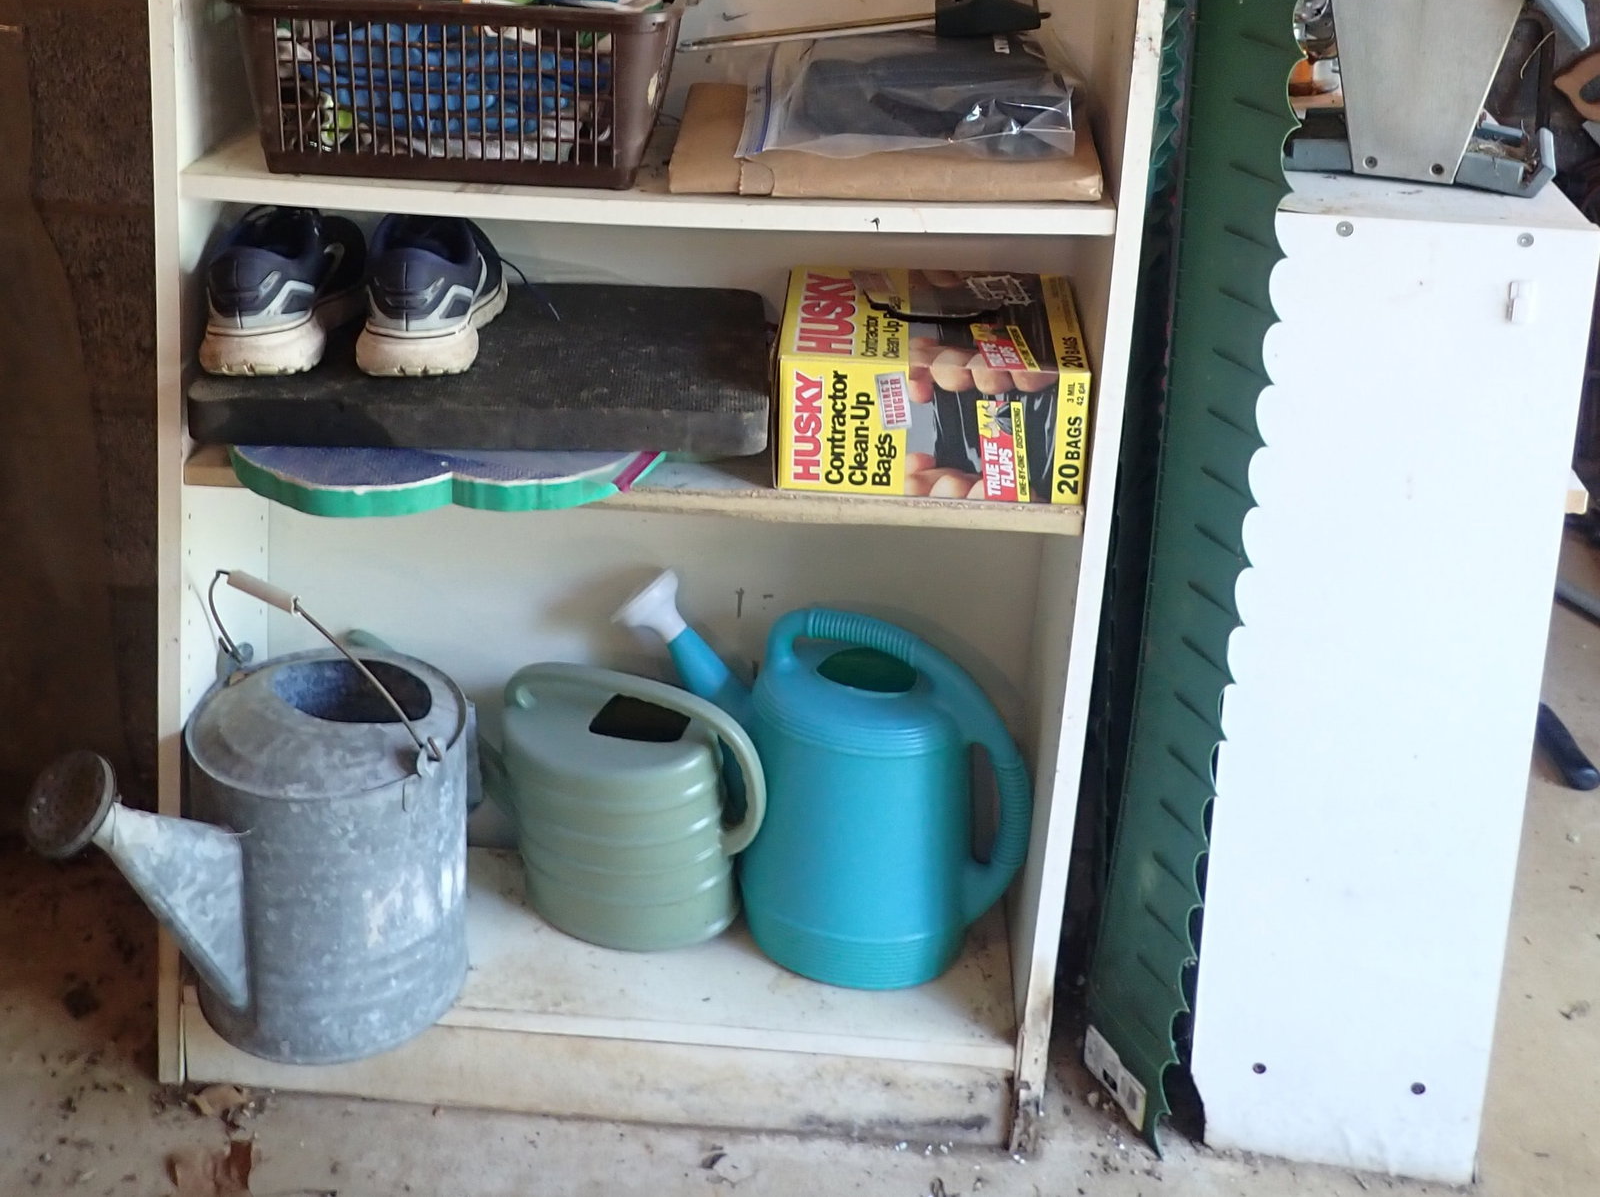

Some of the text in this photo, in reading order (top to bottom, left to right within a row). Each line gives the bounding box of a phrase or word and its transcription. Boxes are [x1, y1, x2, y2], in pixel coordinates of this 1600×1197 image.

[796, 273, 856, 356] HUSKY
[861, 315, 880, 357] Contractor
[882, 320, 904, 359] Clean-Up
[1060, 355, 1084, 369] 20
[1062, 336, 1081, 356] BAGS
[889, 377, 908, 424] TOUGHER
[1067, 381, 1076, 396] MIL
[1076, 396, 1084, 406] 42
[793, 370, 823, 481] HUSKY
[824, 370, 848, 485] Contractor
[847, 392, 875, 486] Clean-Up
[871, 433, 897, 487] Bags
[983, 438, 1002, 497] TRUE TIE
[998, 448, 1016, 488] FLAPS
[1057, 416, 1083, 495] 20 BAGS
